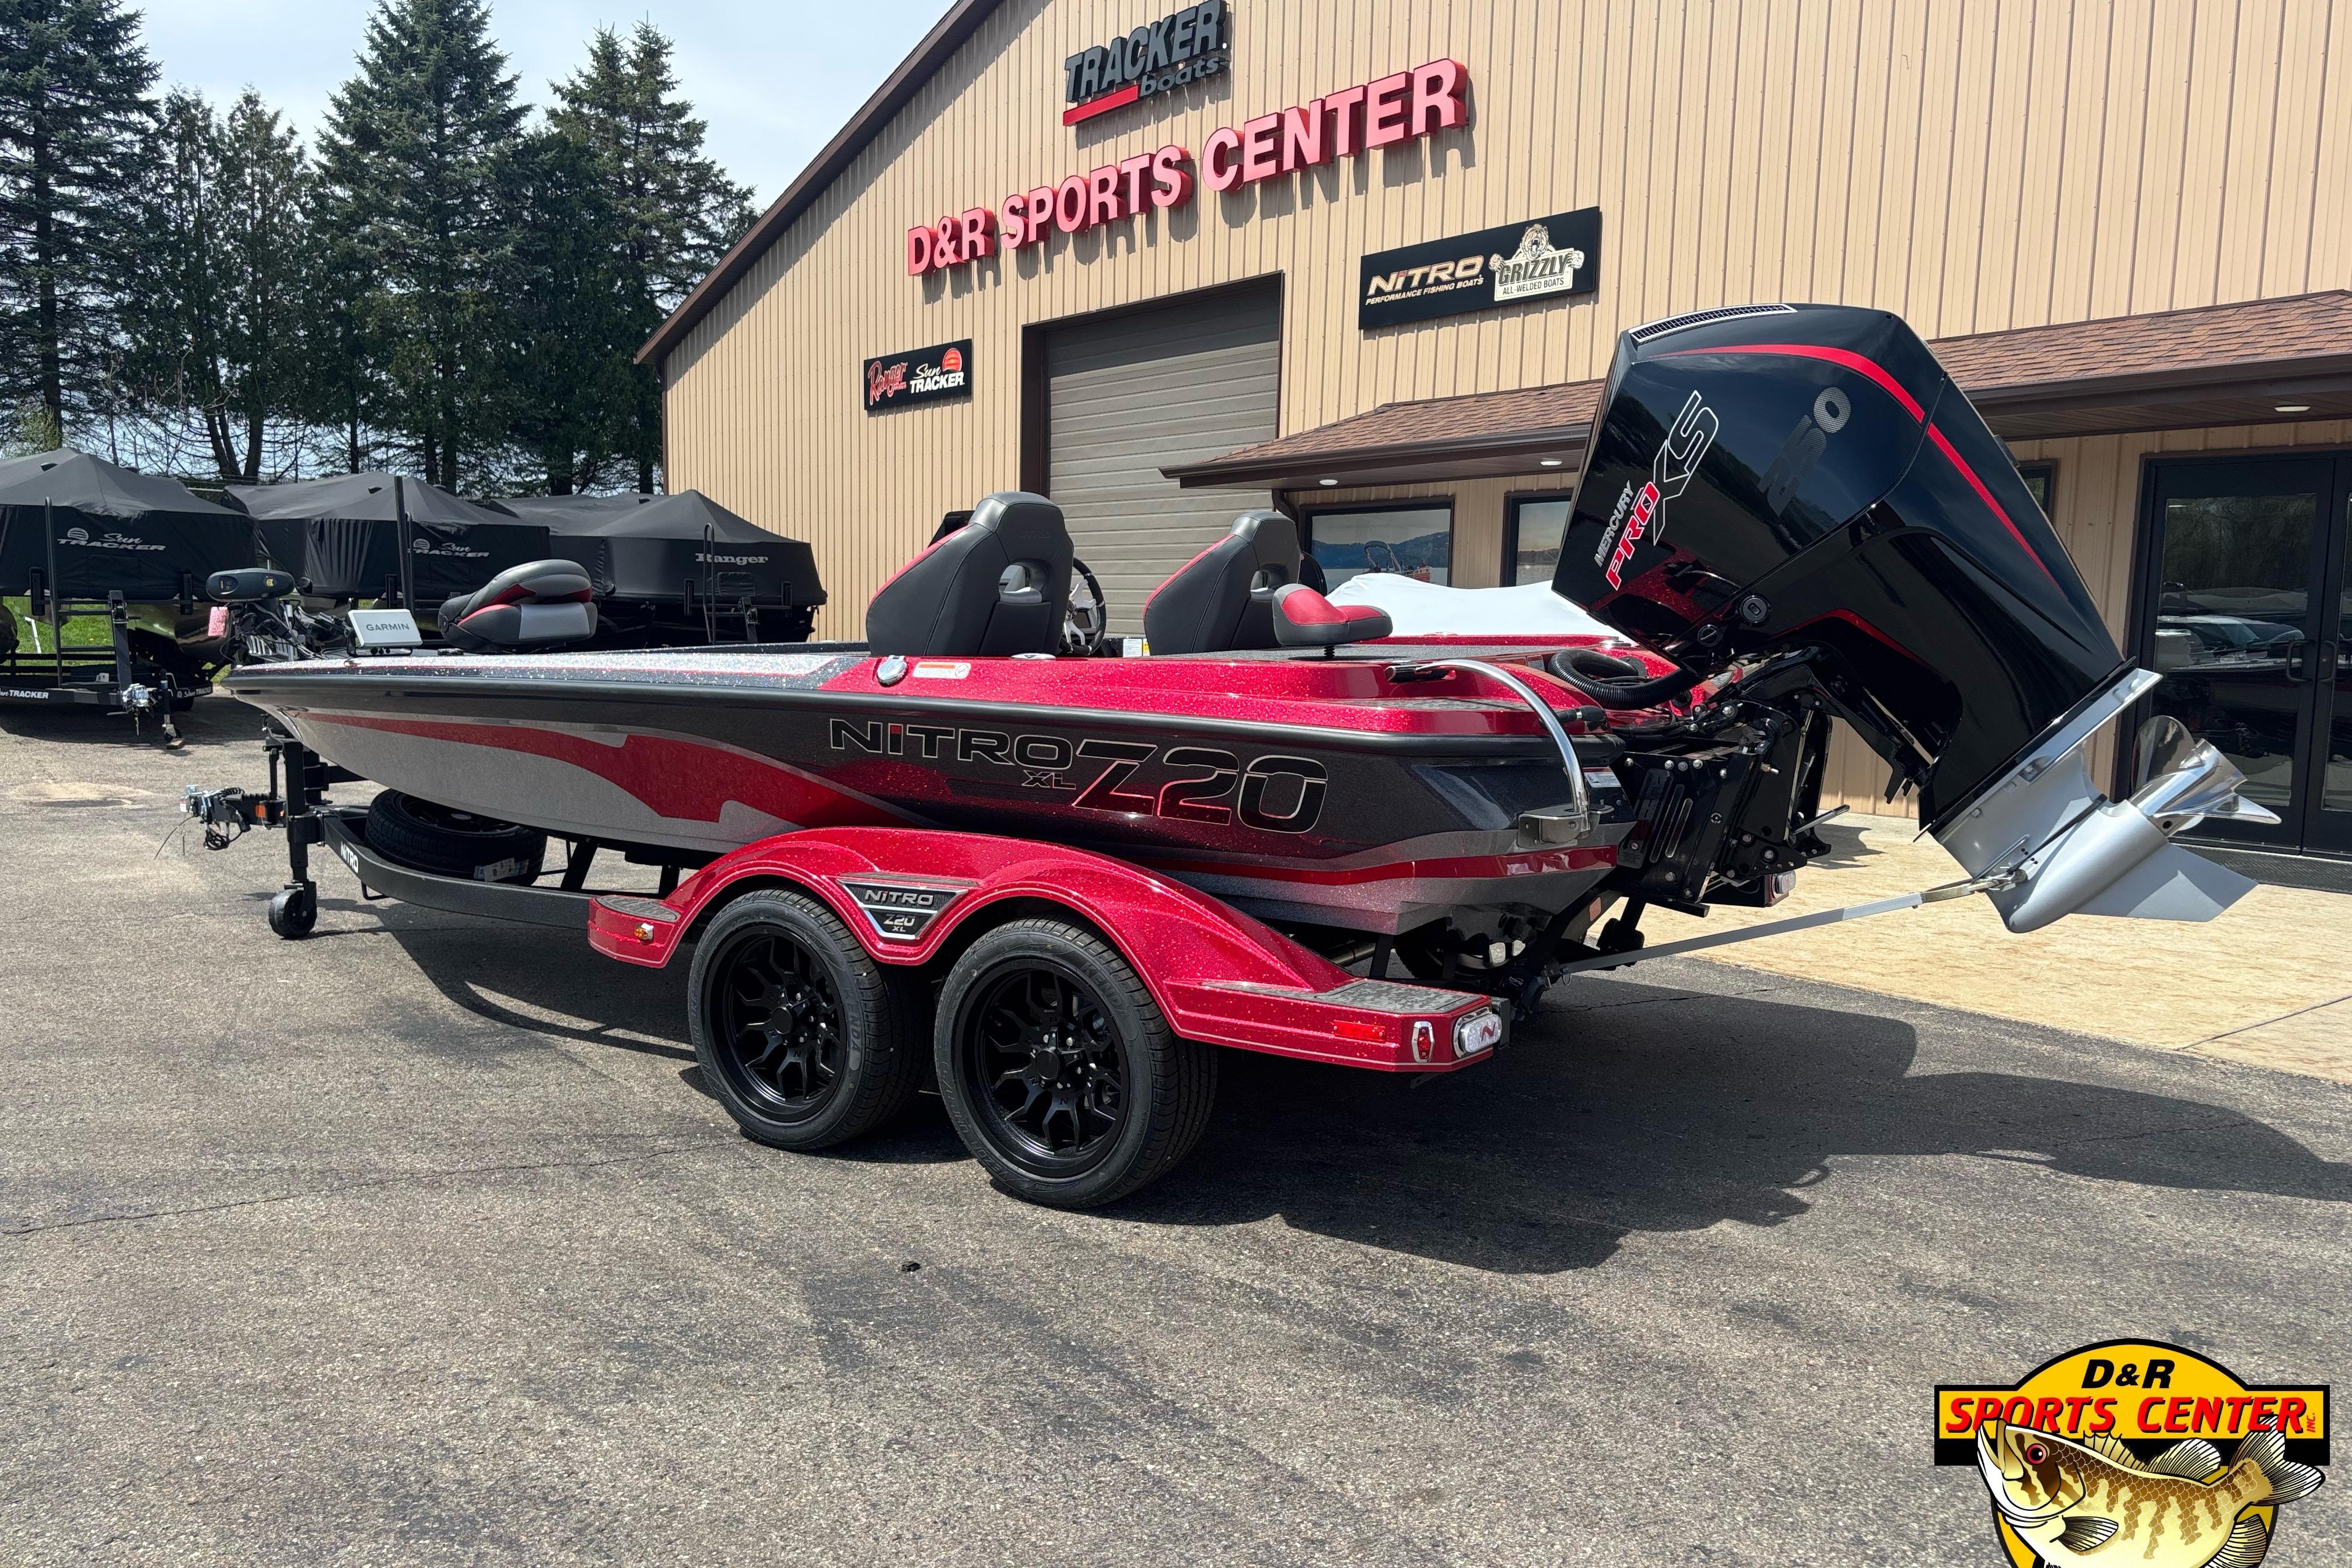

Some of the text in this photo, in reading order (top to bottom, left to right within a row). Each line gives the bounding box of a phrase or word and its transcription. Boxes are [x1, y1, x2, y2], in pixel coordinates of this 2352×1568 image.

[1065, 0, 1225, 103] TRACKER
[1139, 57, 1220, 97] boats
[908, 58, 1468, 276] D&R SPORTS CENTER
[1499, 254, 1569, 286] GRIZZLY
[1366, 276, 1484, 306] PERFORMANCE FISHING BOATS
[1503, 277, 1564, 295] ALL-WELDED BOATS
[867, 360, 908, 405] Ranger
[910, 372, 965, 394] TRACKER
[912, 363, 942, 379] Sun
[99, 533, 143, 544] Sun
[1594, 480, 1634, 568] MERCURY
[1605, 481, 1661, 592] PRO
[57, 538, 166, 551] TRACKER
[439, 542, 471, 552] Sun
[366, 622, 410, 631] GARMIN
[0, 688, 49, 699] un TRACKER
[1021, 769, 1077, 790] XL
[1072, 738, 1328, 834] Z20
[884, 914, 916, 926] Z20
[1080, 962, 1130, 1021] KENDA
[845, 988, 861, 1052] KENDA
